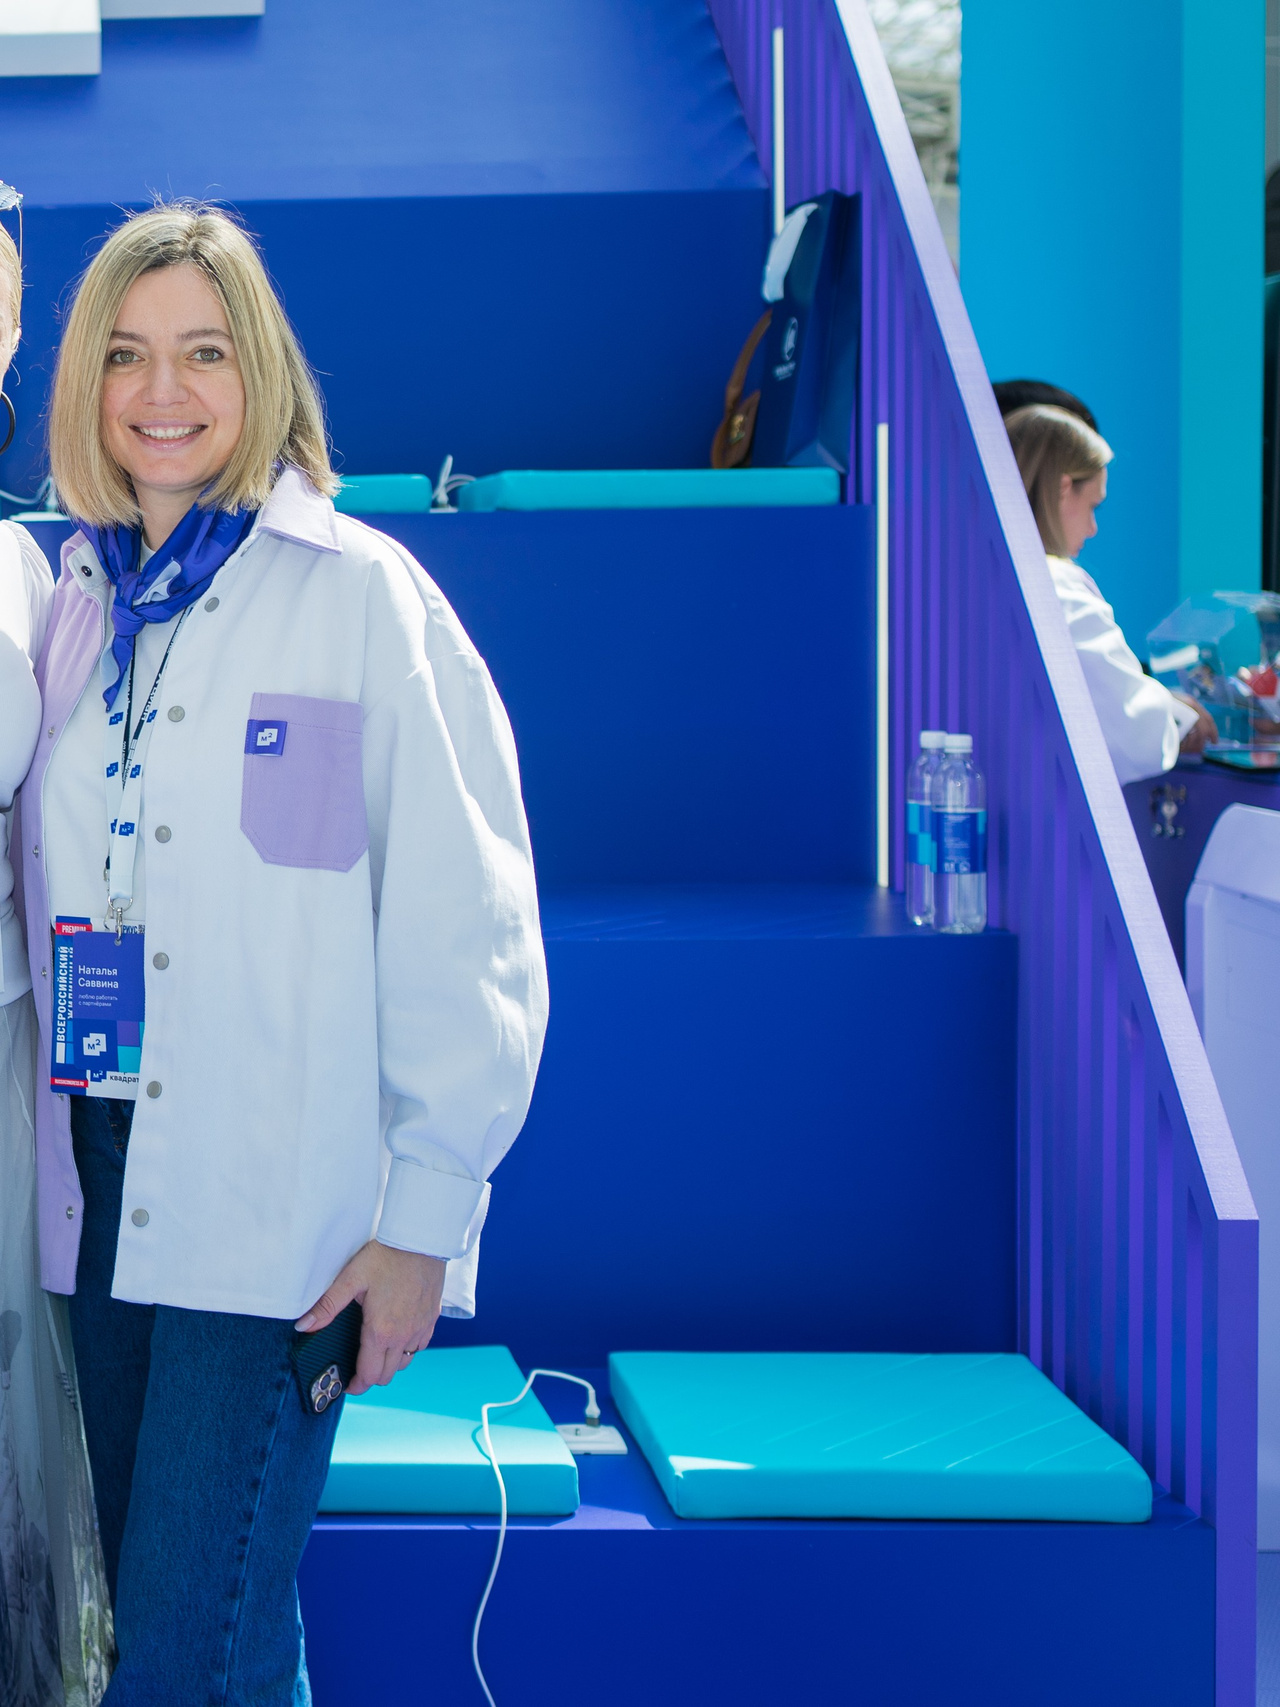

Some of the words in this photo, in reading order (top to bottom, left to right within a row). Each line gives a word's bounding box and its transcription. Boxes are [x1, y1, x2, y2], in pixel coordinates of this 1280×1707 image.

[122, 924, 138, 934] РИУС
[78, 965, 118, 976] Наталья
[78, 977, 119, 989] Саввина
[56, 946, 68, 1041] ВСЕРОССИЙСКИЙ
